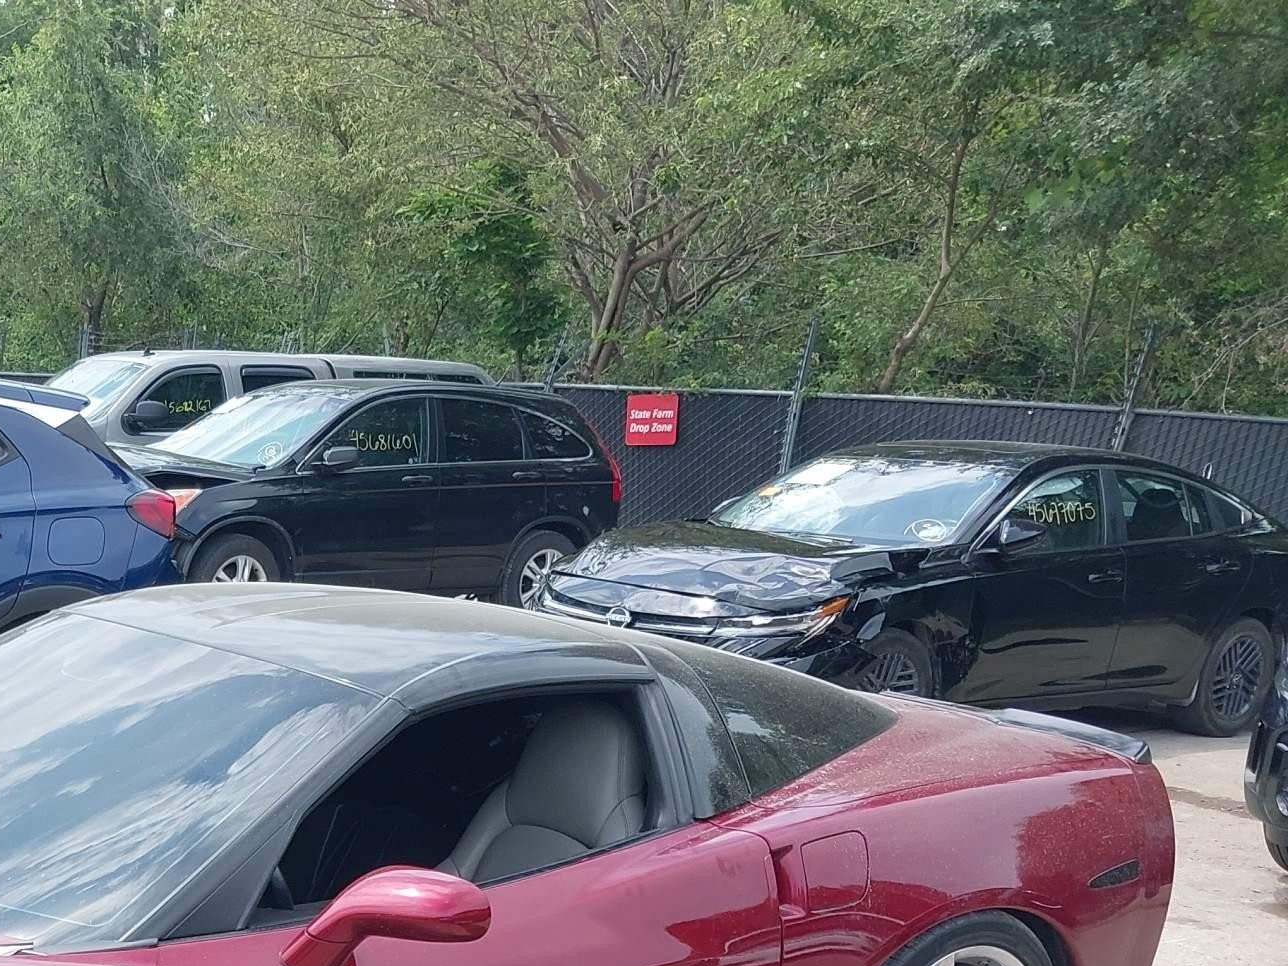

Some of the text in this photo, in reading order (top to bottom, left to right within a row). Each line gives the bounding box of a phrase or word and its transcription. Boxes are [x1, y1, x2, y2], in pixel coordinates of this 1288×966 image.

[629, 408, 674, 420] State Farm
[629, 422, 673, 434] Drop Zone
[349, 429, 419, 456] 45681601
[1028, 502, 1097, 526] 45697075
